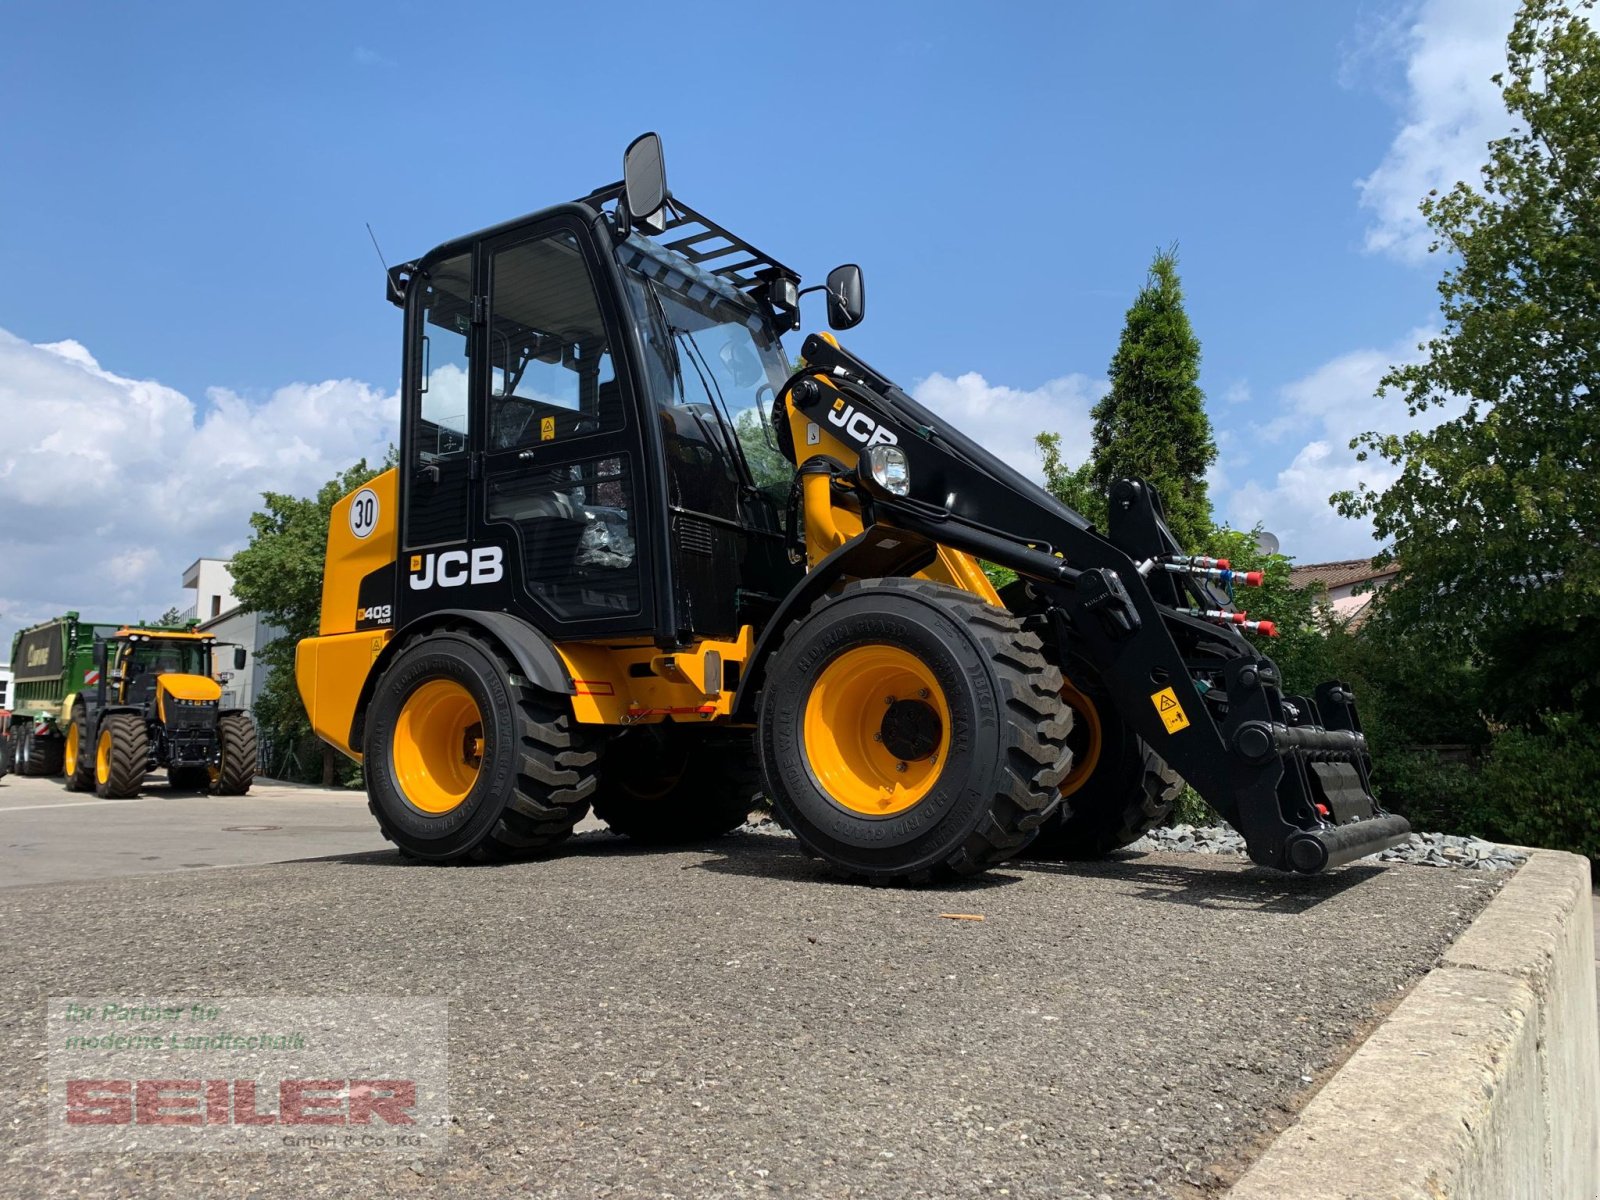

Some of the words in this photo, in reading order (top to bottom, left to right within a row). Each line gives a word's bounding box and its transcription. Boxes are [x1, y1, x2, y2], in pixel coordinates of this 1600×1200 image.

[354, 498, 374, 529] 30
[410, 546, 503, 590] JCB
[365, 605, 391, 619] 403
[973, 679, 992, 711] BKT
